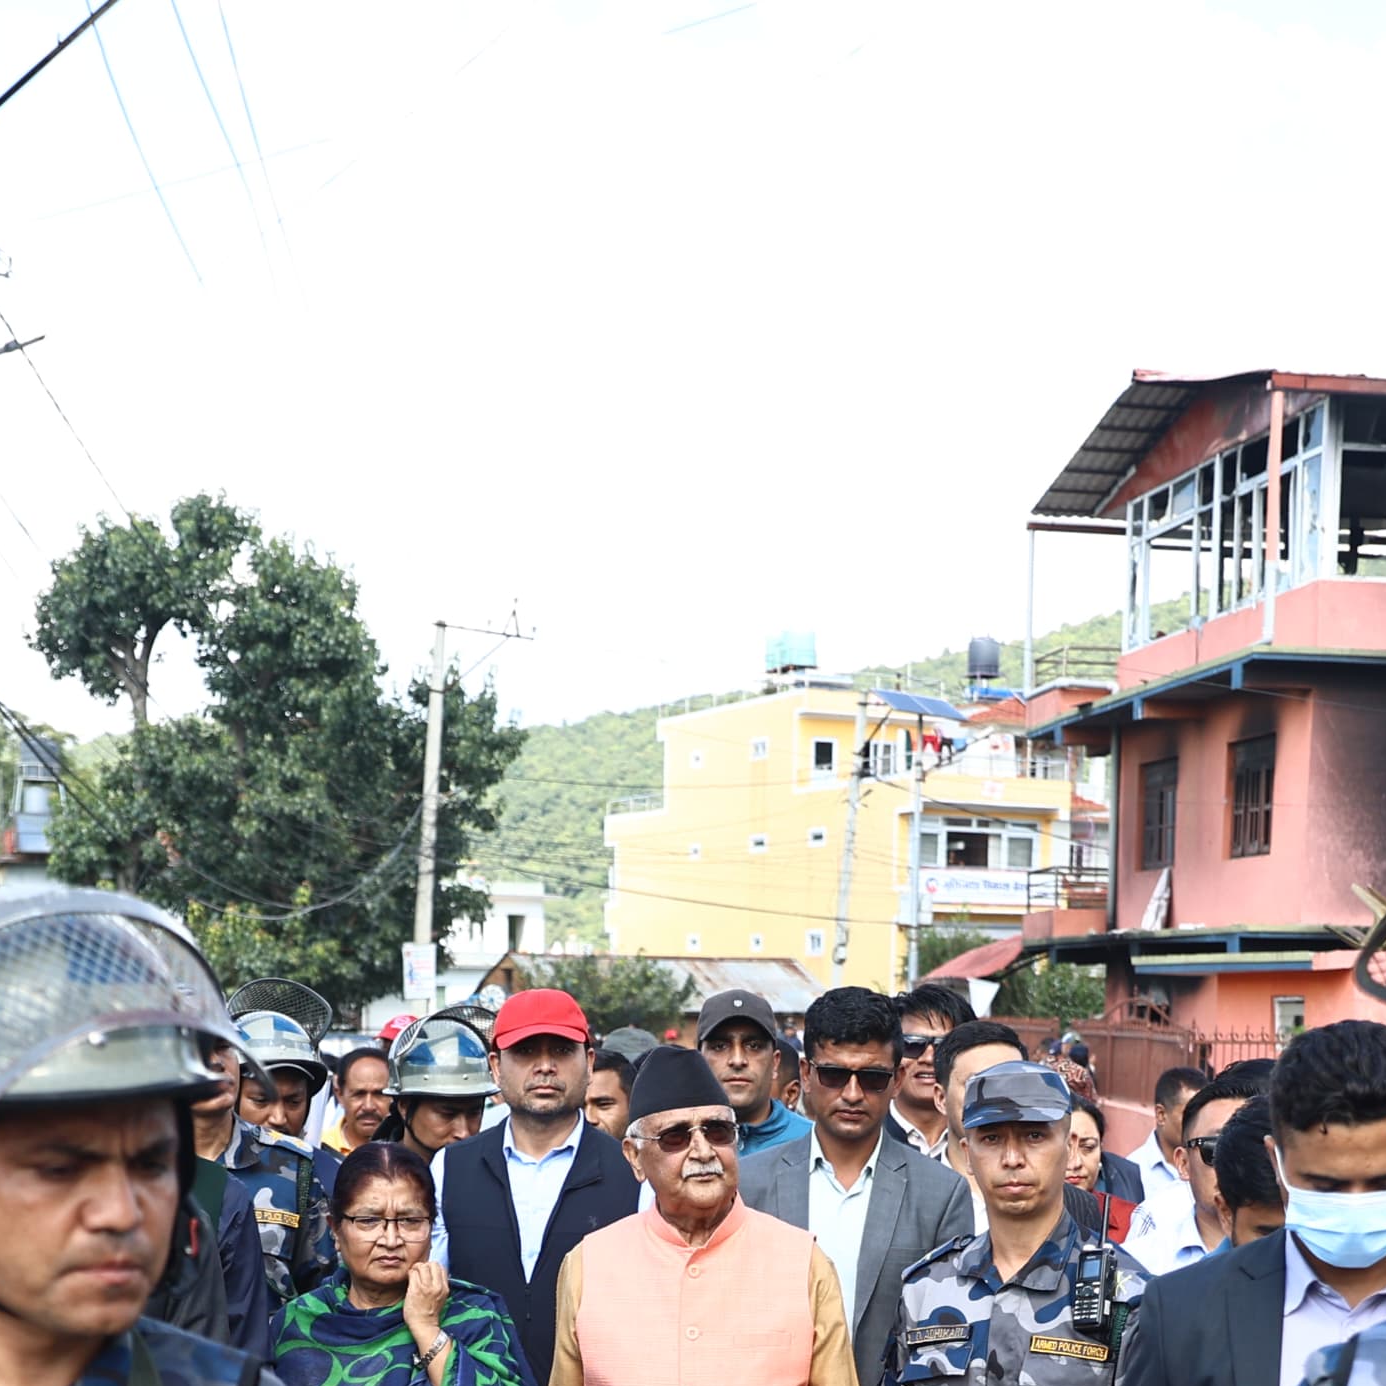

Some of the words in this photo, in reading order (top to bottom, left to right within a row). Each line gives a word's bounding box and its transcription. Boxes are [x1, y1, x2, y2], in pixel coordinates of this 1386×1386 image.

[1035, 1339, 1058, 1350] ARMED
[1058, 1341, 1082, 1354] POLICE
[1083, 1345, 1105, 1358] FORCE
